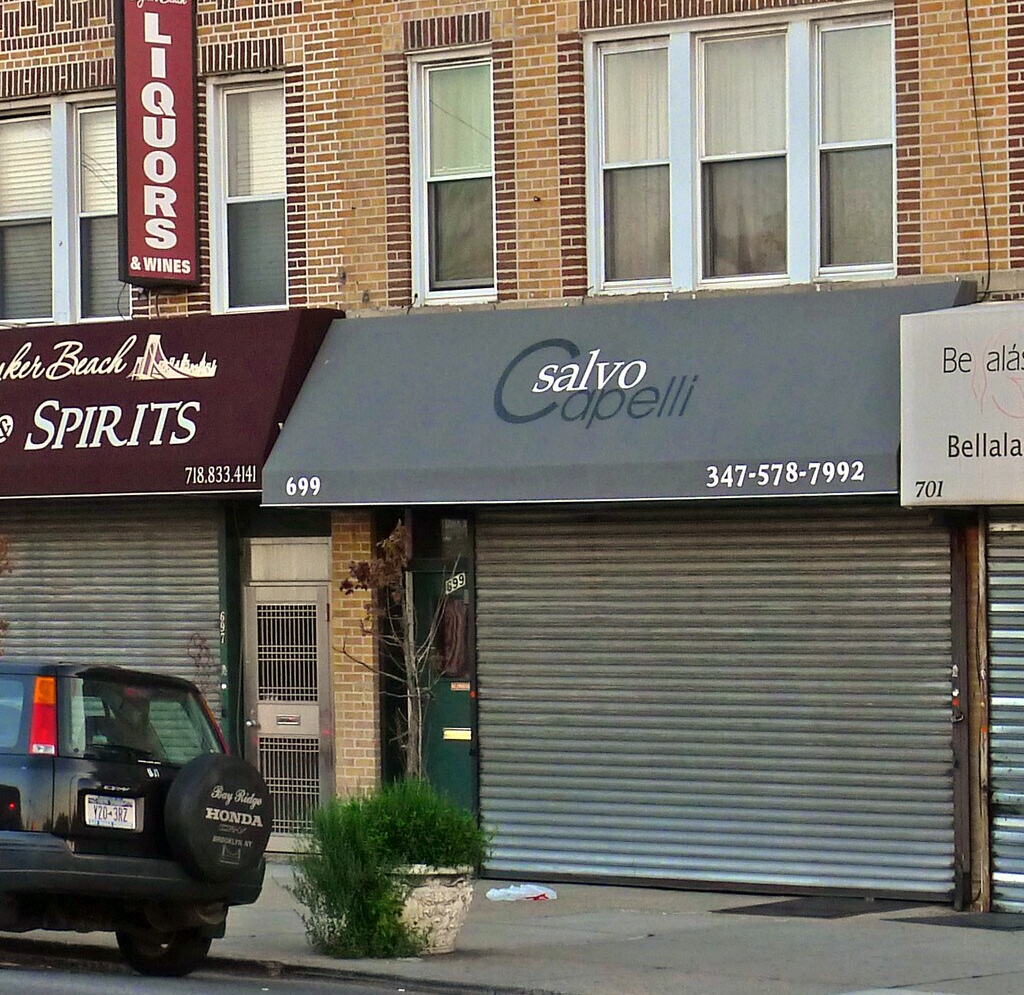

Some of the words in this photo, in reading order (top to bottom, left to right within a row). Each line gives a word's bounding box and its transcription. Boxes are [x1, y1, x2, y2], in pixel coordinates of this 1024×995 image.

[141, 12, 178, 249] LIQUORS
[130, 256, 142, 270] &
[143, 257, 191, 274] WINES
[45, 334, 137, 380] Beach
[532, 348, 647, 393] salvo
[493, 337, 700, 430] Capelli
[23, 399, 201, 450] SPIRITS
[184, 465, 257, 485] 718.833.4141
[706, 460, 865, 488] 347-578-7992
[285, 476, 321, 497] 699
[915, 480, 944, 499] 701
[446, 574, 465, 592] 699
[211, 785, 234, 806] Bay
[234, 789, 263, 810] Ridge
[205, 807, 263, 827] HONDA
[244, 840, 254, 848] NY
